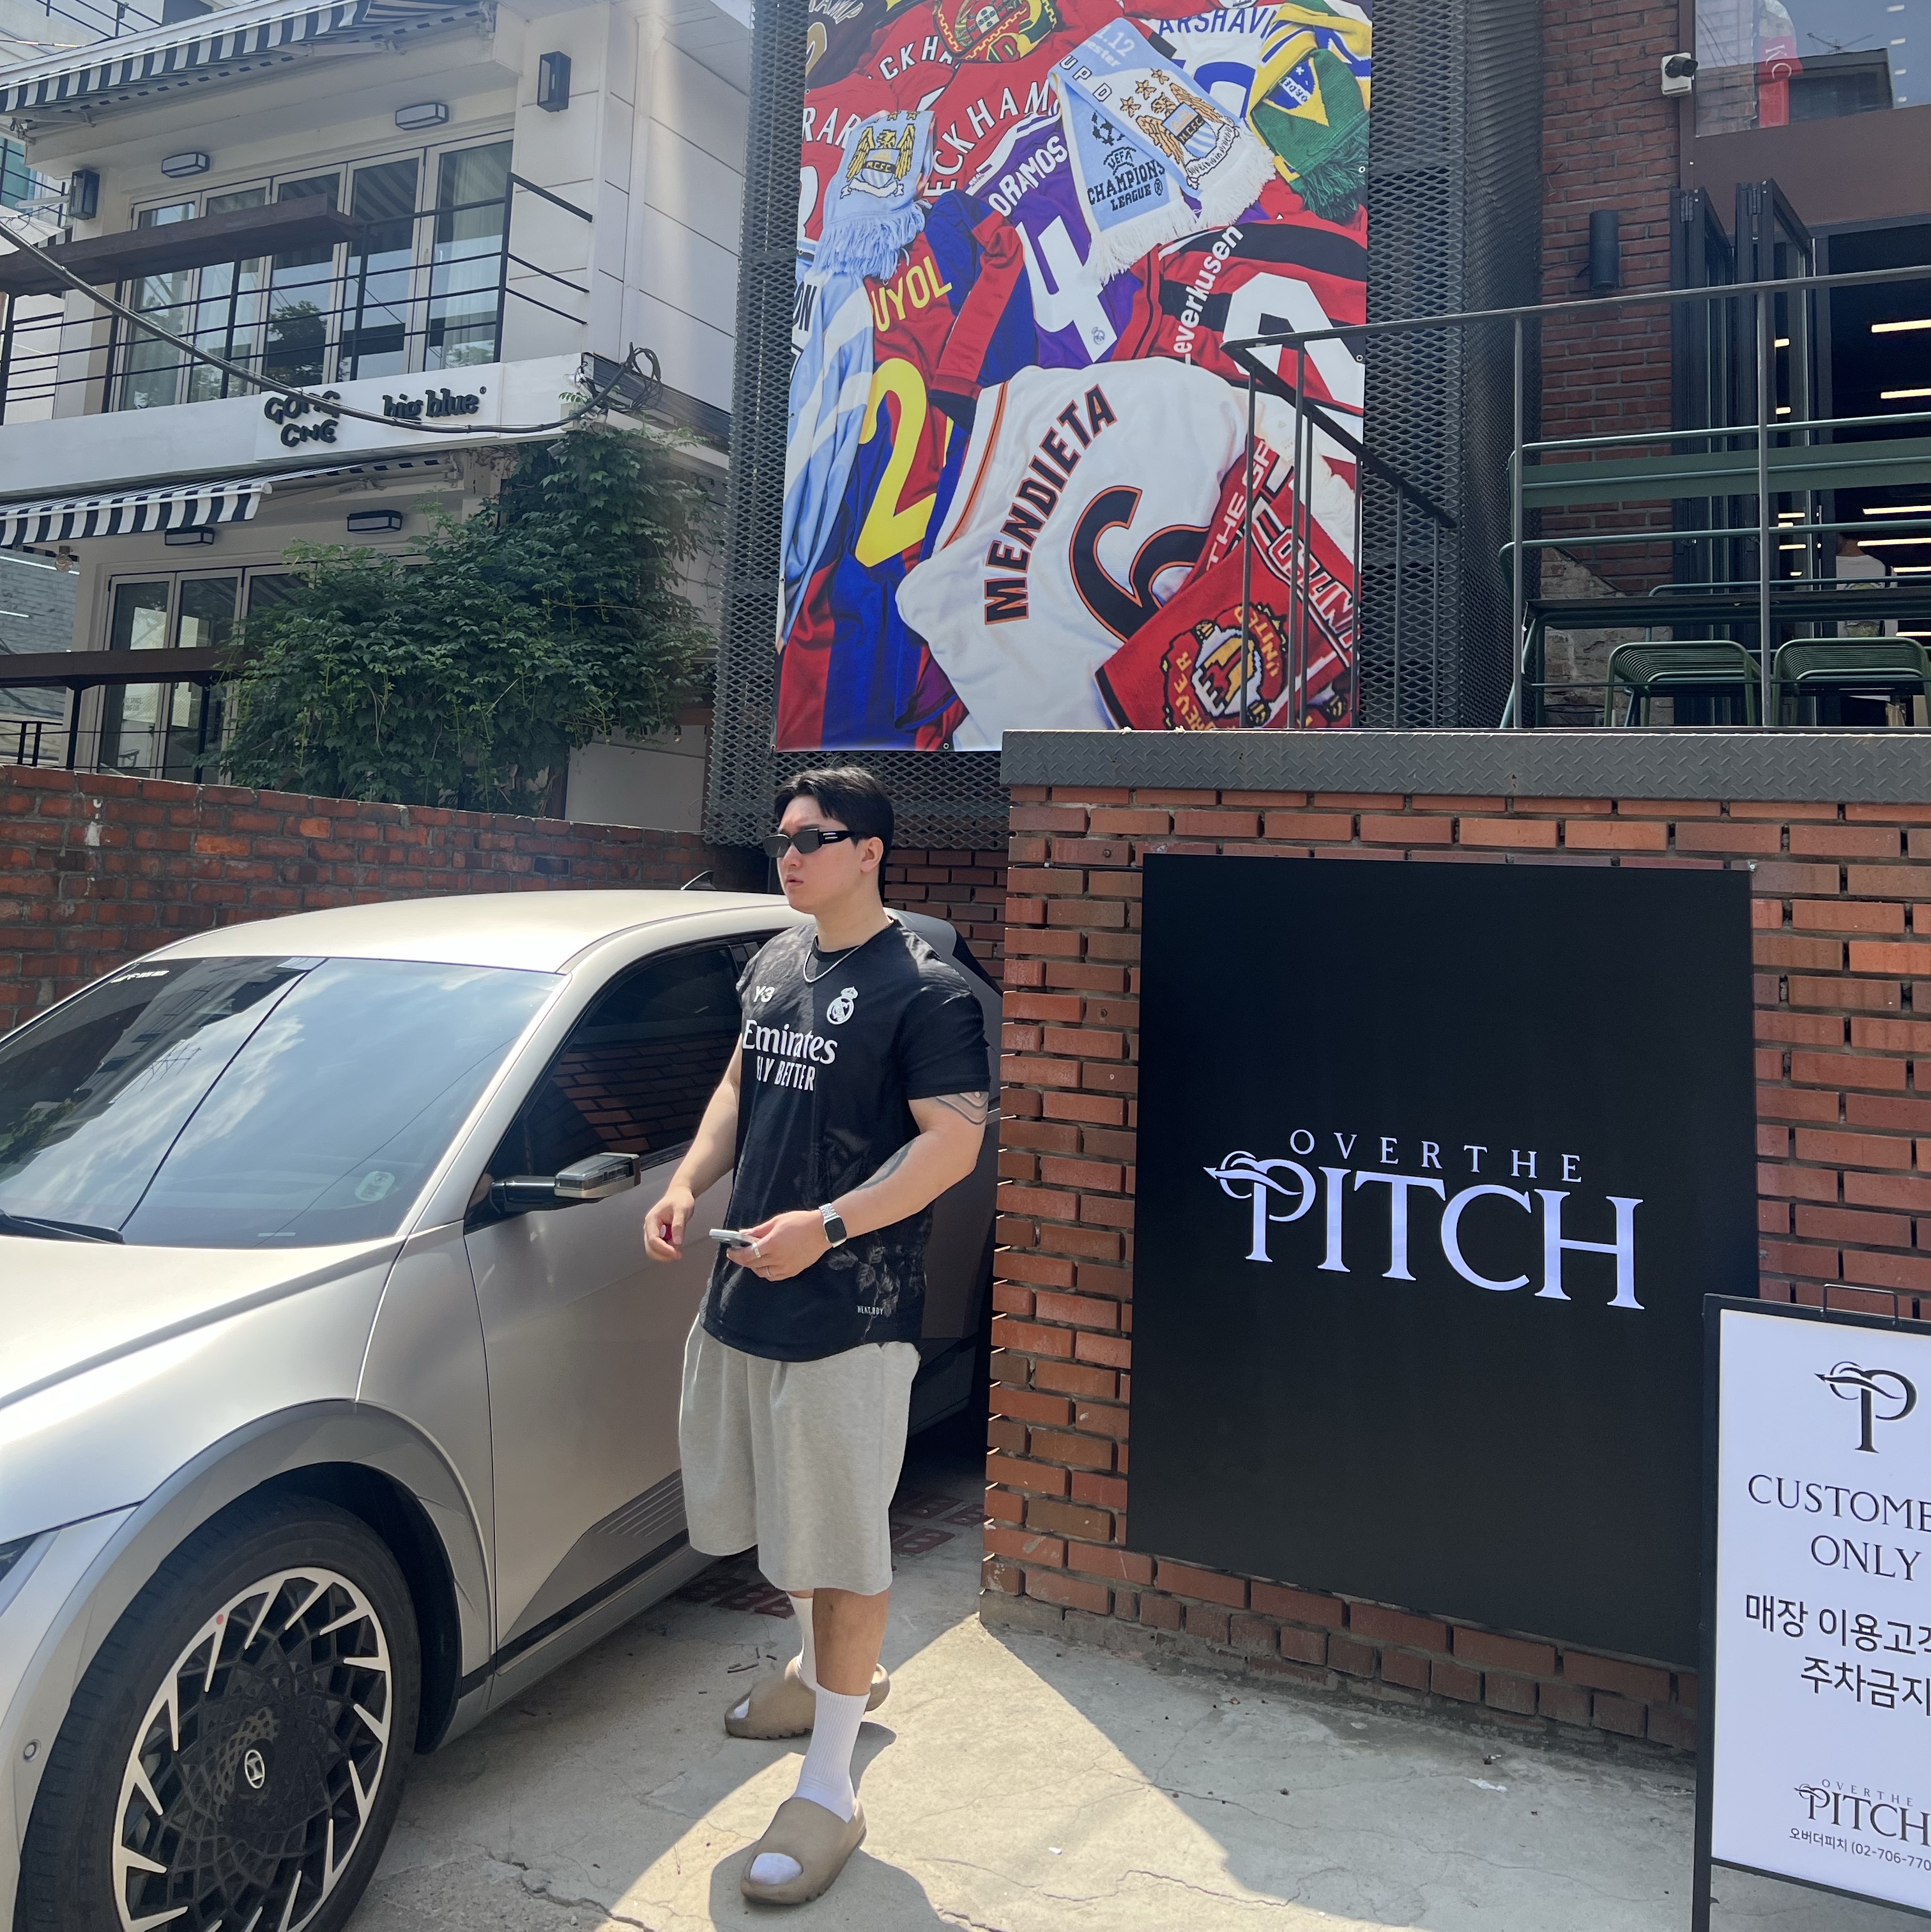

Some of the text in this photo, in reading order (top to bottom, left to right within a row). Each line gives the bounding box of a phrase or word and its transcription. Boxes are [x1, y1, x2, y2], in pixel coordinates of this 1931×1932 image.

[1107, 150, 1134, 170] UEFA
[1110, 185, 1152, 212] LEAGUE
[870, 256, 952, 332] UYOL
[425, 388, 480, 418] blue
[984, 383, 1118, 625] MENDIETA
[742, 1019, 838, 1064] Emirates
[774, 1060, 816, 1092] BETTER
[1203, 1151, 1645, 1310] PITCH
[1811, 1535, 1923, 1581] ONLY
[1746, 1594, 1809, 1639] 매장
[1789, 1827, 1848, 1853] 오버더피치
